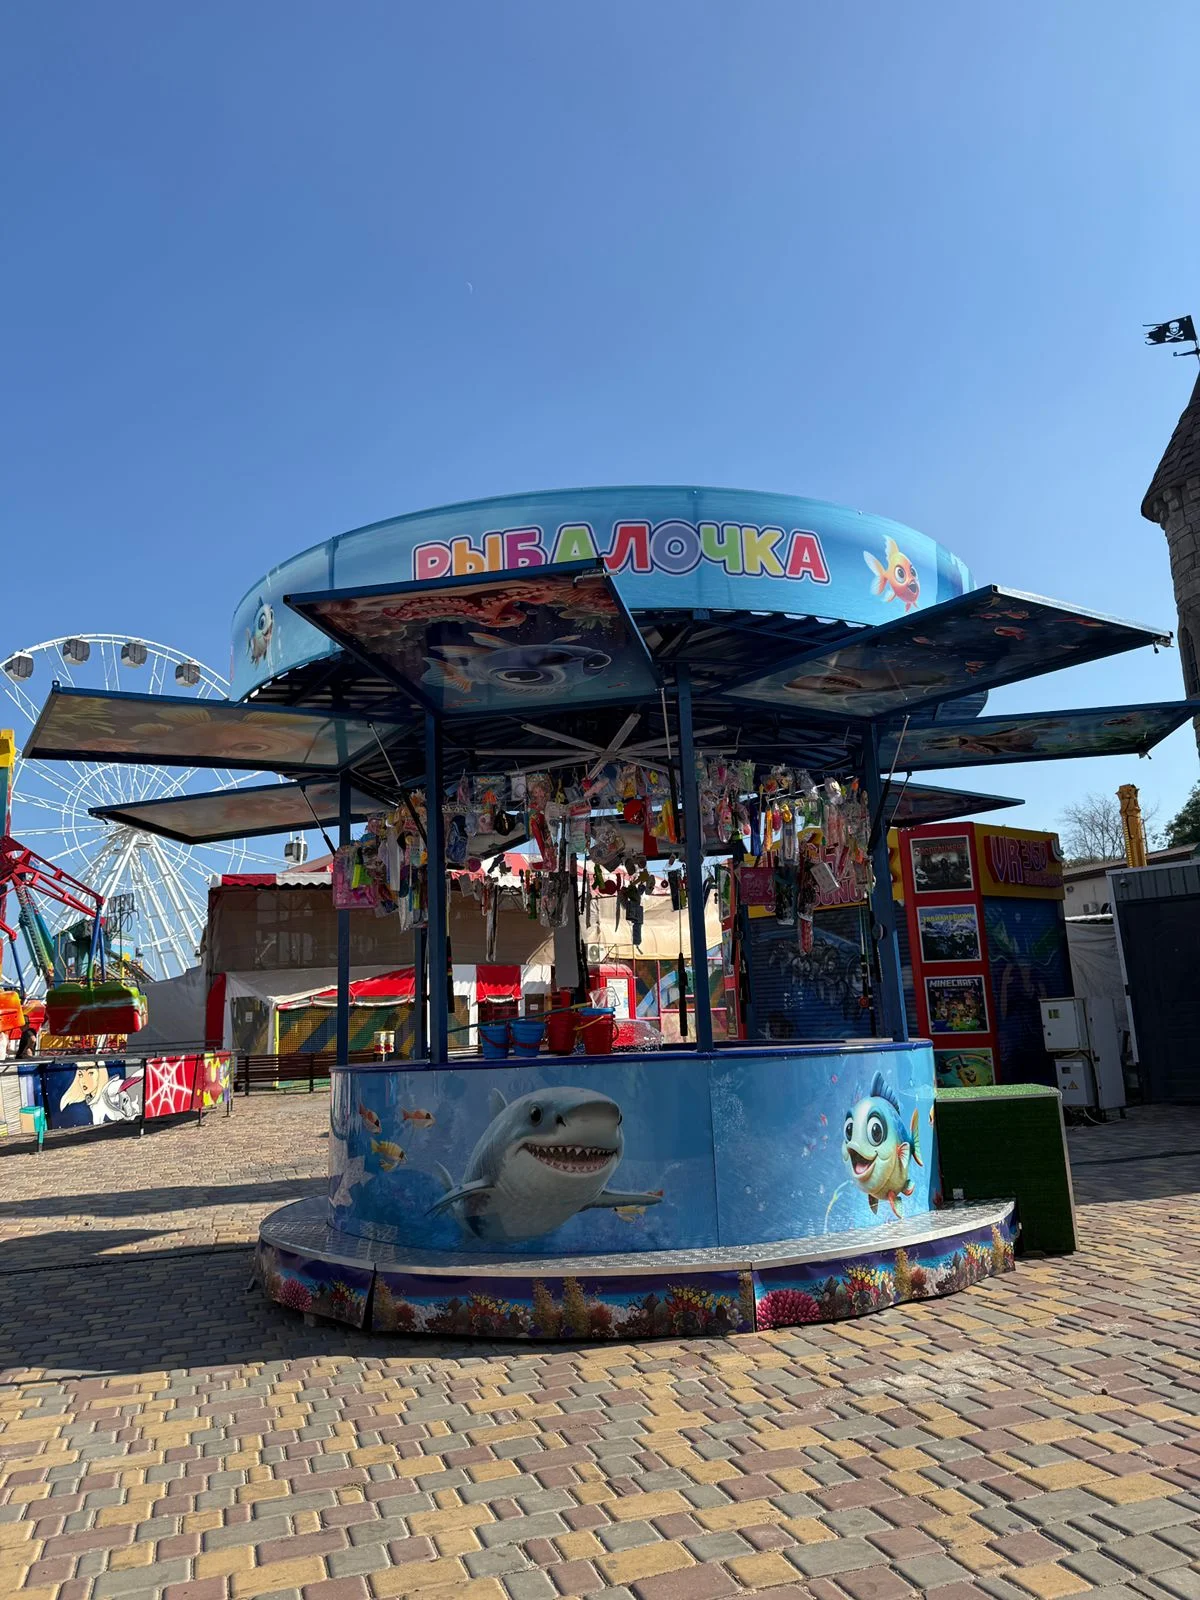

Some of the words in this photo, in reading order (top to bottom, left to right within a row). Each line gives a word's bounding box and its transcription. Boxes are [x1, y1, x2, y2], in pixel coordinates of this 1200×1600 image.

[412, 519, 831, 585] РЫБАЛОЧКА
[990, 835, 1024, 883] VR
[1022, 840, 1048, 871] 360
[929, 979, 979, 988] MINECRAFT
